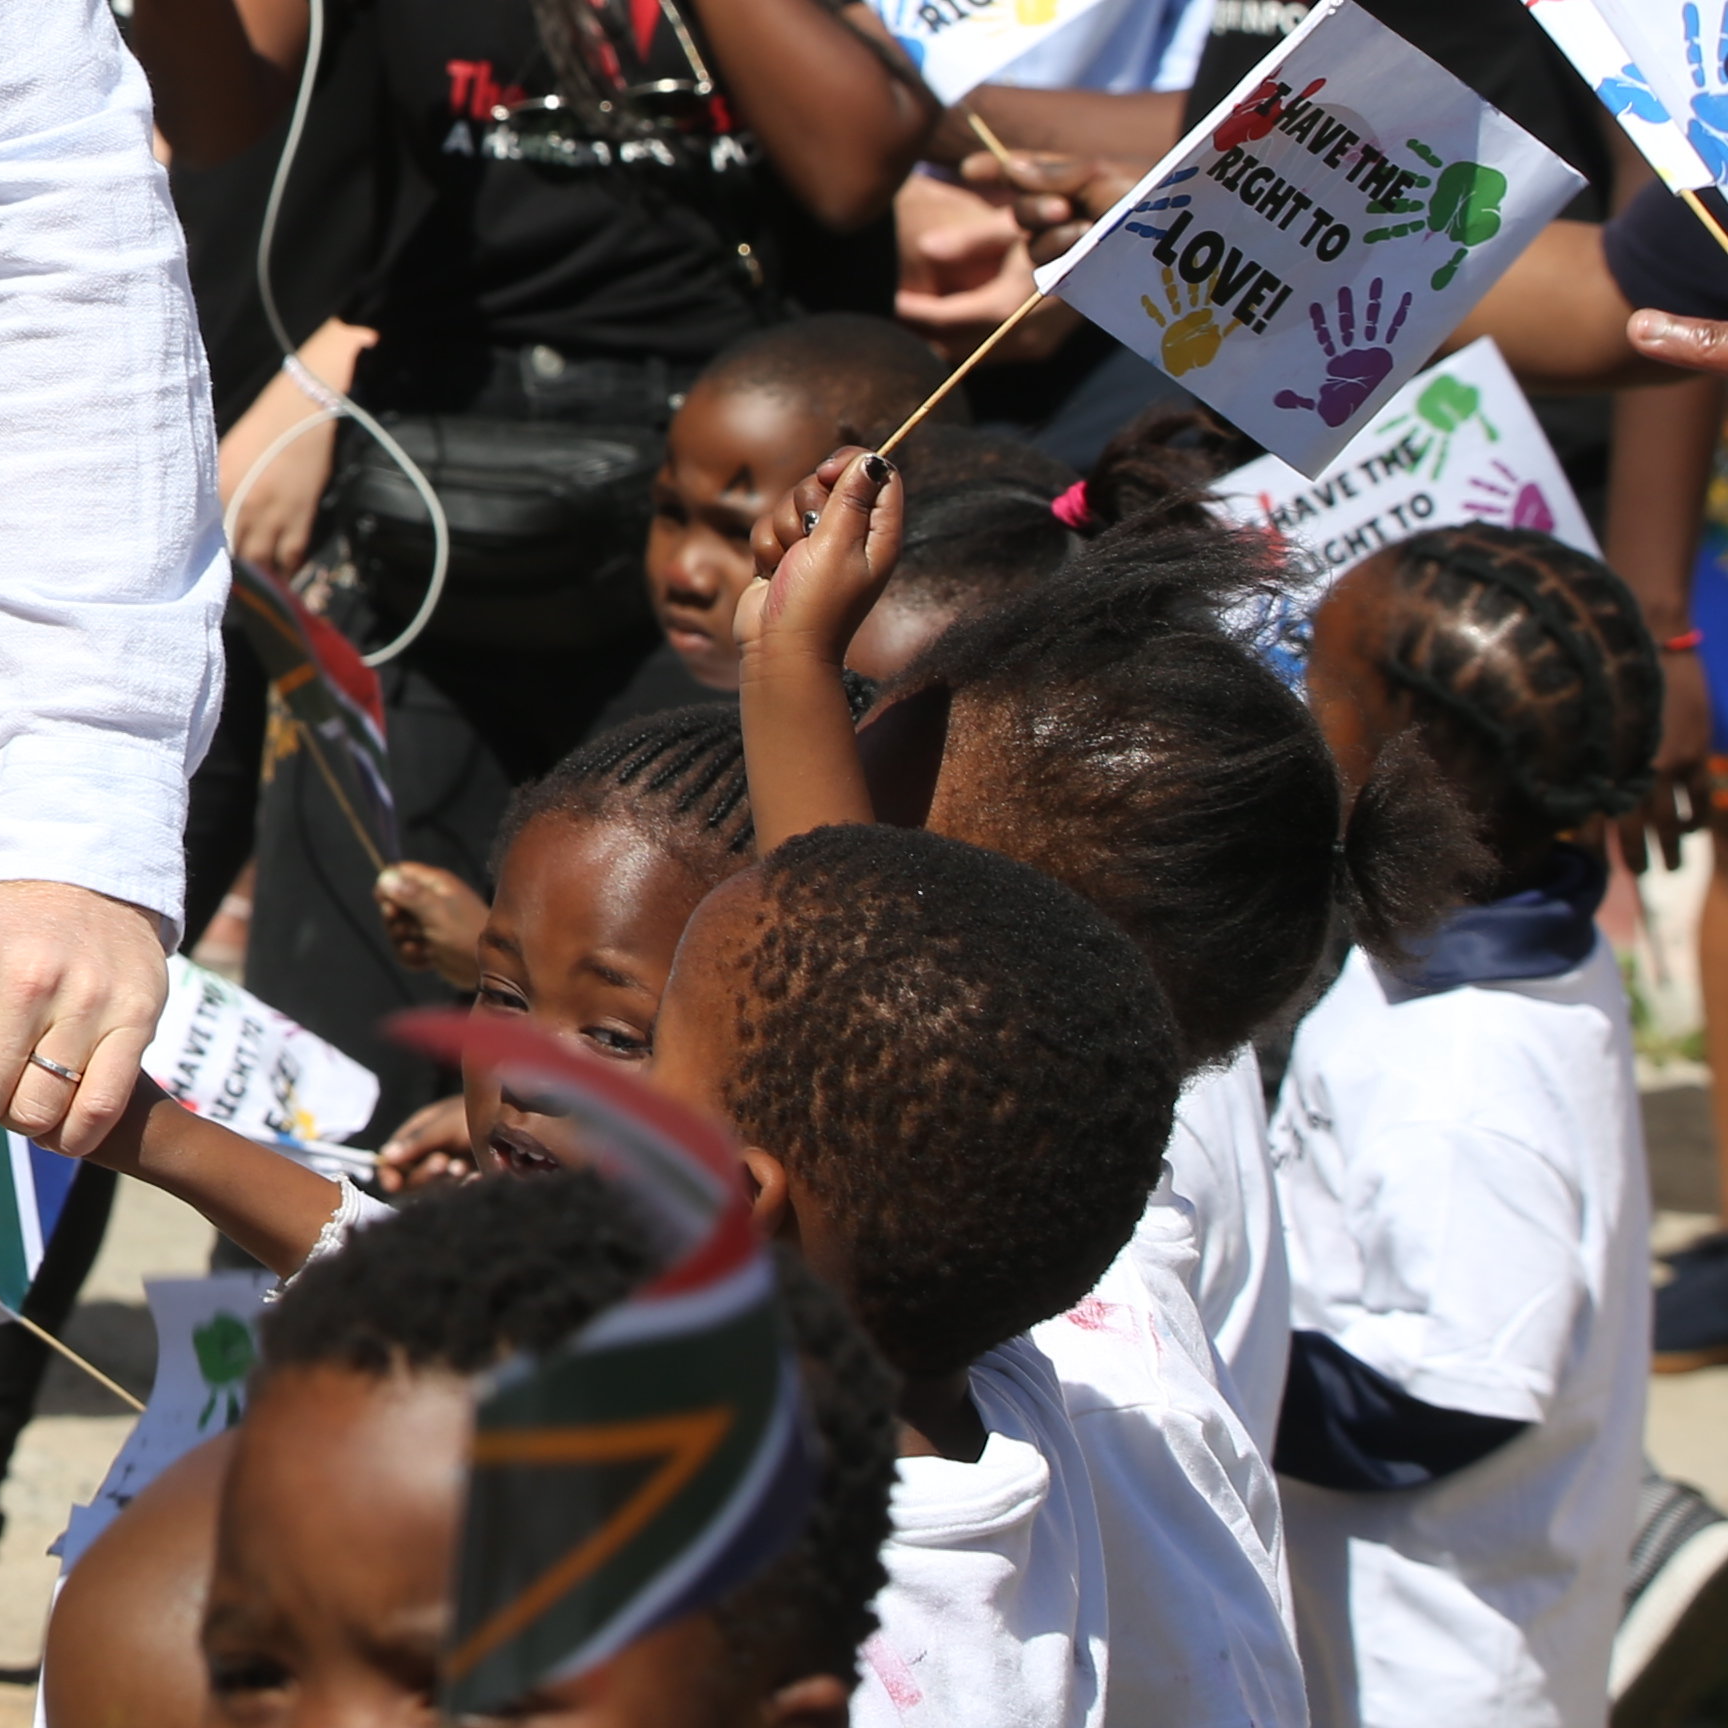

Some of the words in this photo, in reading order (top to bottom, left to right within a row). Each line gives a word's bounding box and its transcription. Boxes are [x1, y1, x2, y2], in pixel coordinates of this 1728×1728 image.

[1206, 145, 1313, 231] RIGHT
[1299, 207, 1351, 262] TO
[1254, 82, 1292, 116] I
[1273, 95, 1361, 170] HAVE
[1345, 143, 1416, 213] THE
[1152, 210, 1294, 335] LOVE!
[1272, 475, 1361, 532] HAVE
[1360, 432, 1424, 486] THE
[1308, 516, 1391, 572] IGHT
[1392, 492, 1435, 532] TO
